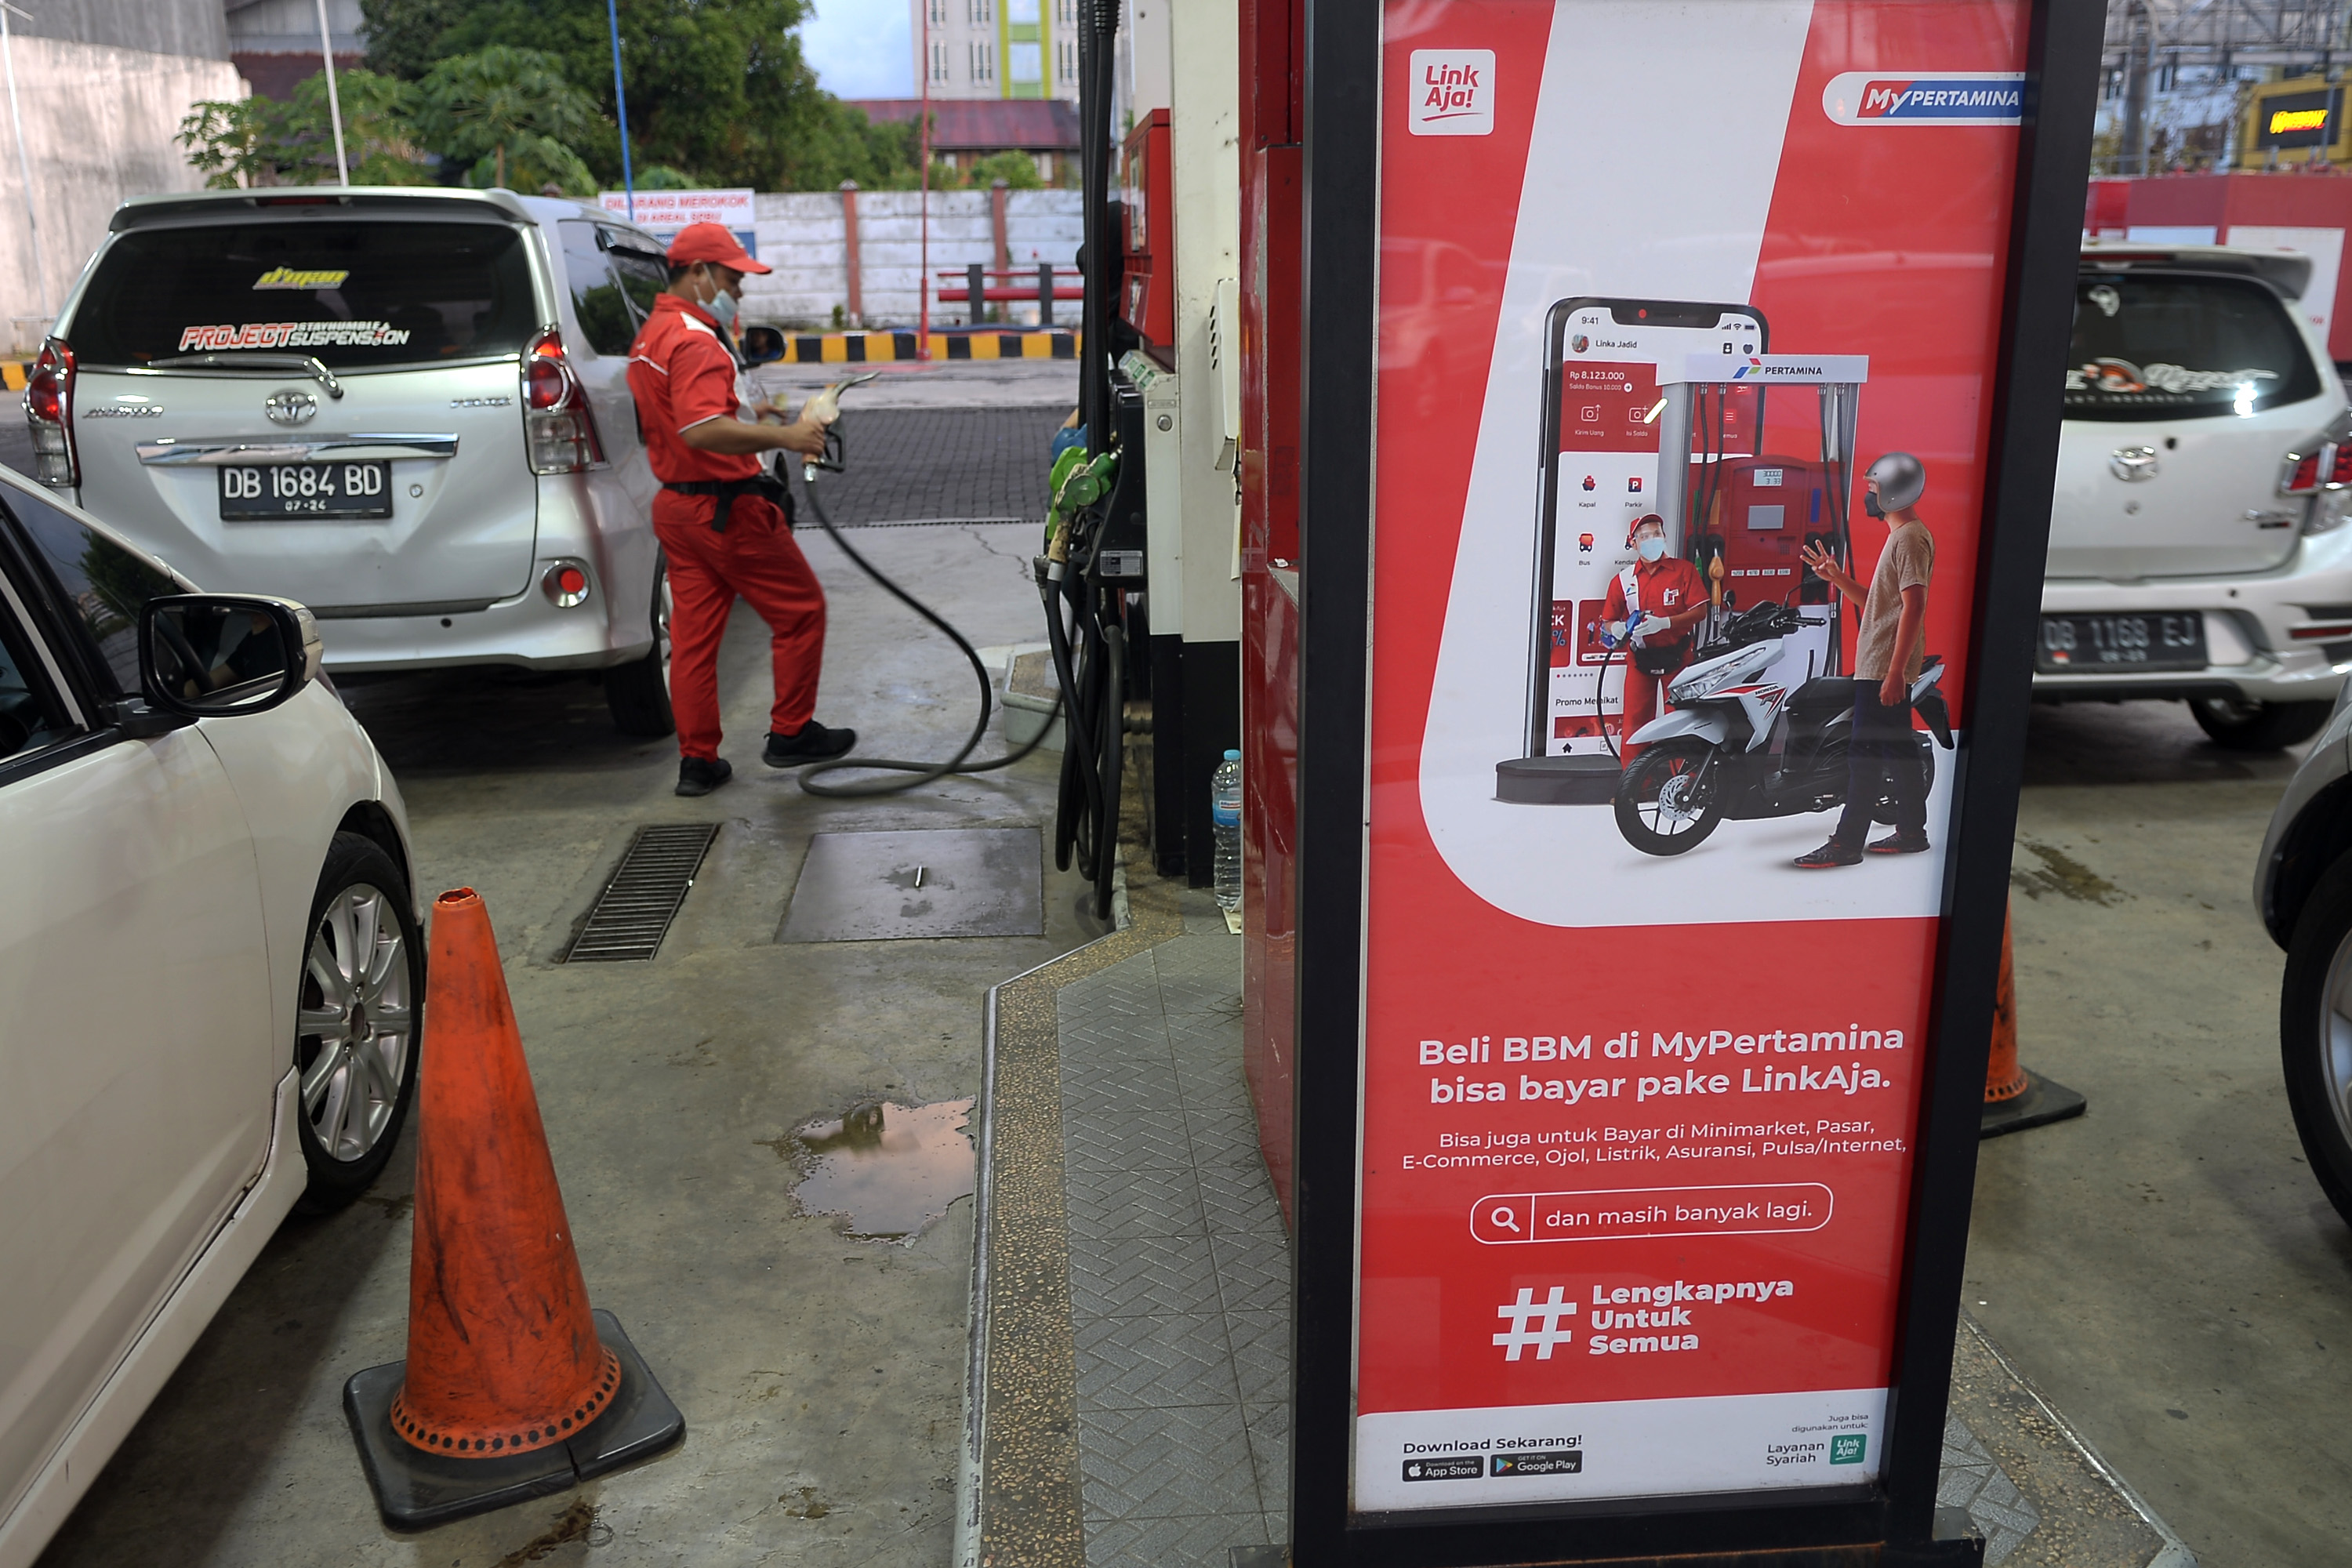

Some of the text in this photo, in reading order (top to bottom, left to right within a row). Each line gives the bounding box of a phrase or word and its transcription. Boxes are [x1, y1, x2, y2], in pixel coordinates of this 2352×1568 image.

[1425, 64, 1479, 88] Link
[1425, 85, 1474, 112] Aja!
[1581, 316, 1599, 325] 9:41
[179, 323, 297, 352] PROJECT
[1595, 339, 1638, 349] Linka Jadid
[1570, 371, 1625, 381] Rp 8.123.000
[1765, 366, 1823, 376] PERTAMINA
[224, 464, 383, 499] DB 1684 BD
[1755, 685, 1779, 695] HONDA
[1420, 1022, 1904, 1065] Beli BBM di MyPertamina
[1431, 1062, 1891, 1105] bisa bayar pake LinkAja.
[1439, 1118, 1876, 1150] Bisa juga untuk Bayar di Minimarket, Pasar,
[1403, 1137, 1907, 1170] E-Commerce, Ojol, Listrik, Asuransi, Pulsa/Internet,
[1545, 1200, 1813, 1227] dan masih banyak lagi.
[1592, 1279, 1795, 1308] Lengkapnya
[1591, 1306, 1693, 1330] Untuk
[1588, 1334, 1700, 1356] Semua
[1791, 1425, 1838, 1433] digunakan
[1403, 1434, 1583, 1454] Download Sekarang!
[1767, 1439, 1860, 1454] Layanan Link
[1517, 1461, 1577, 1473] Google Play
[1766, 1446, 1858, 1467] Syariah Aja!
[1425, 1465, 1478, 1478] App Store
